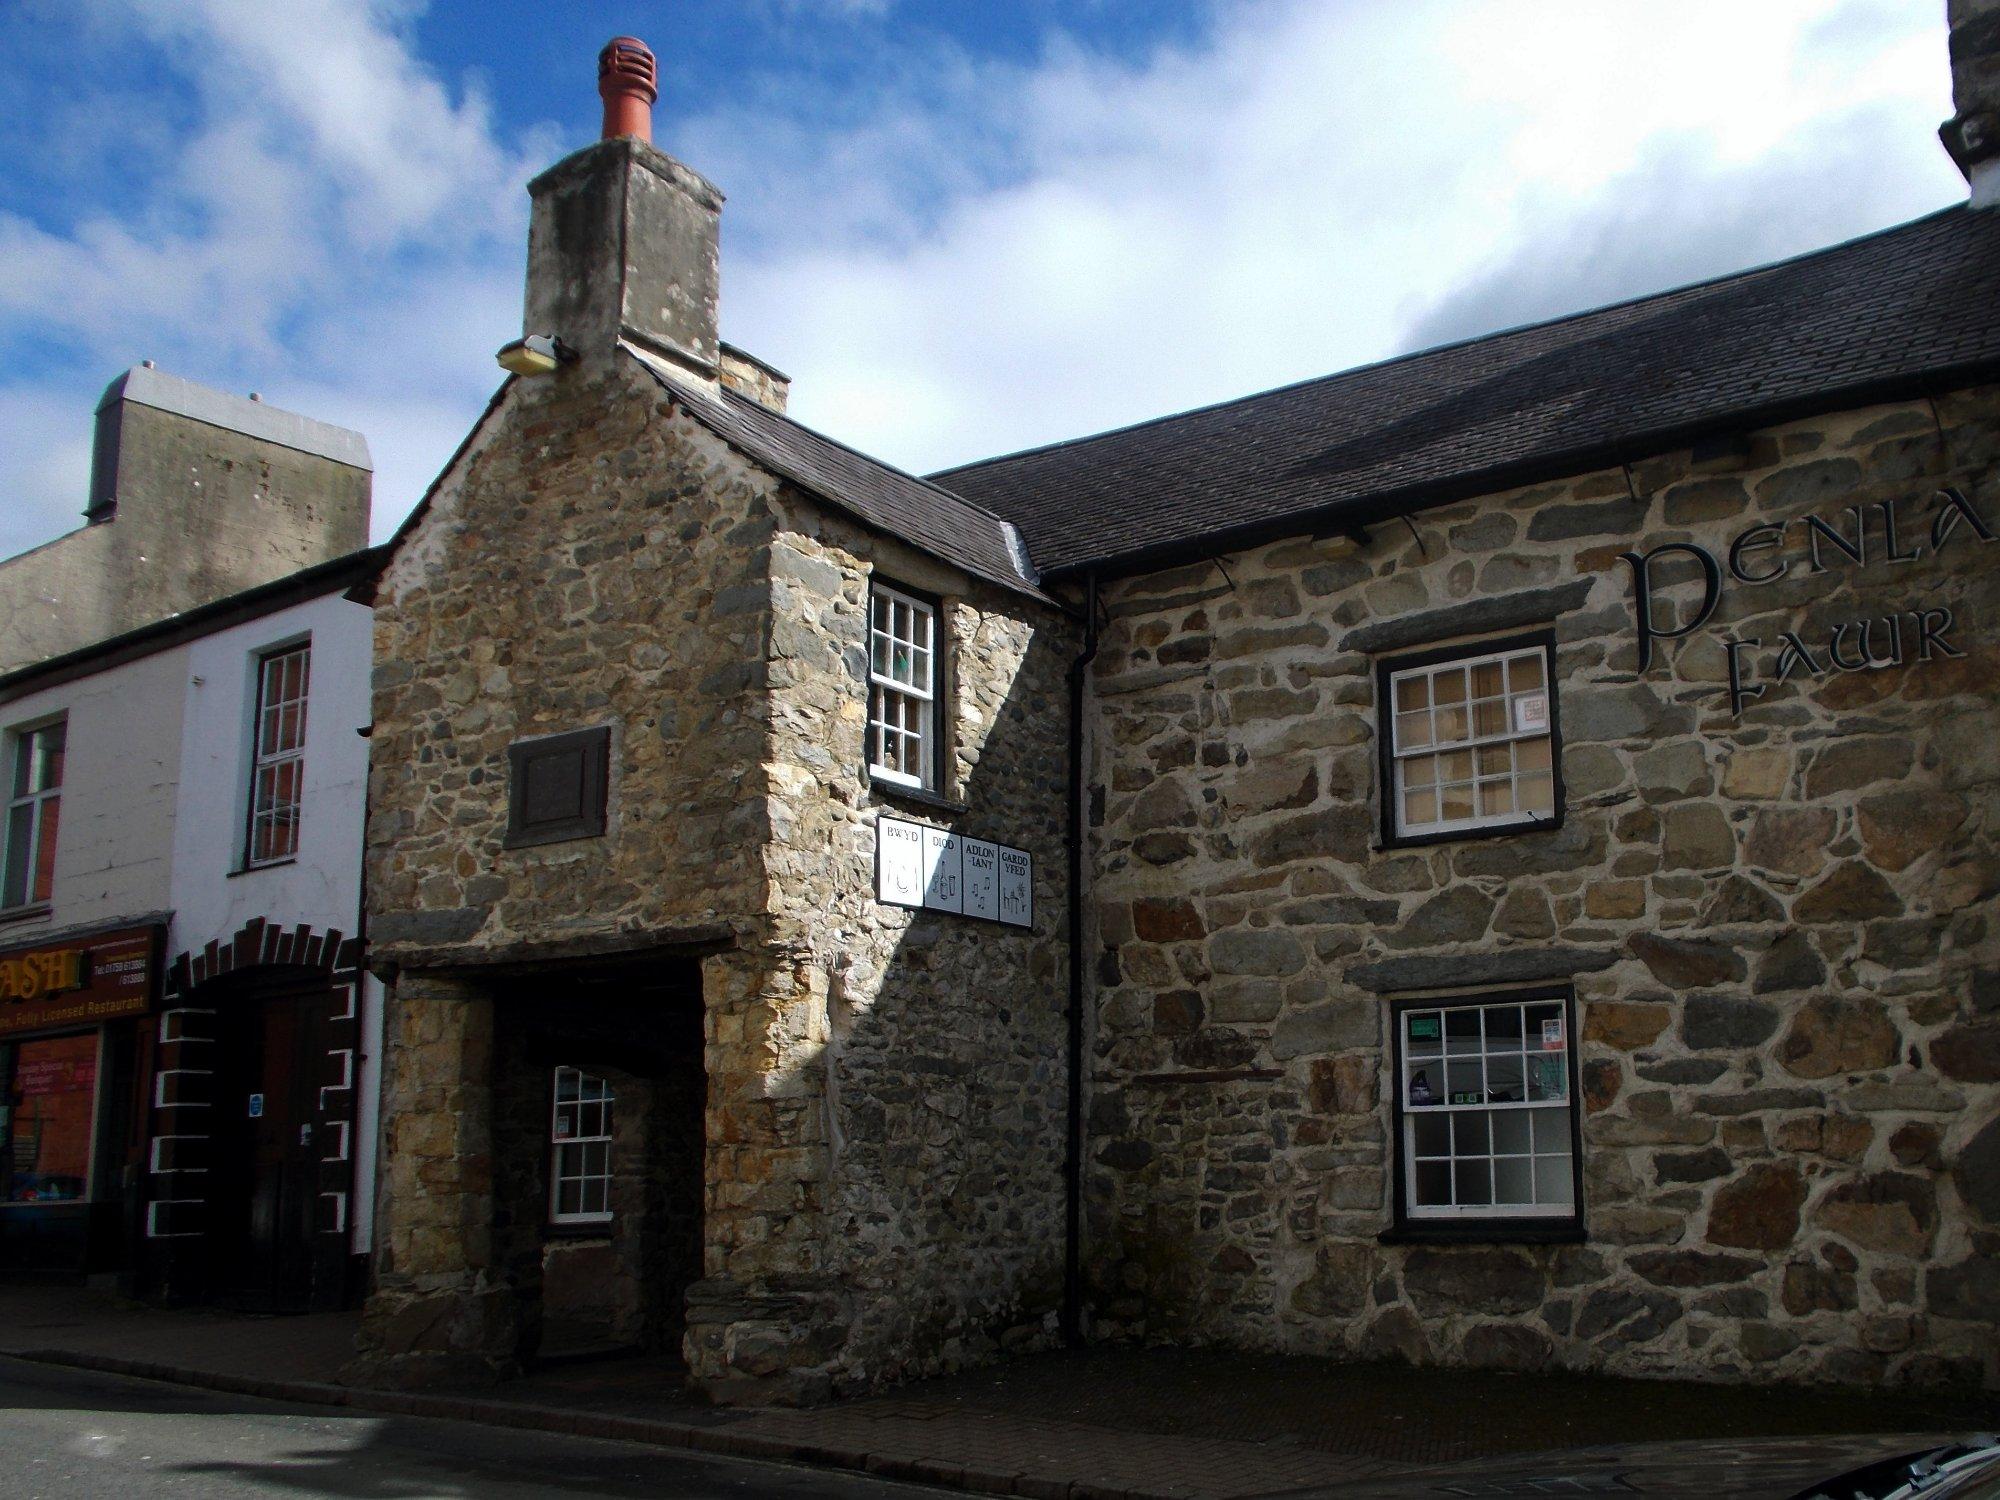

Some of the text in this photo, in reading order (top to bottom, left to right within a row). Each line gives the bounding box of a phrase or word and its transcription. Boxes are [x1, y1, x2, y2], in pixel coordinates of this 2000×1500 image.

[1721, 606, 1968, 719] FAWR
[887, 826, 918, 842] BWYD
[932, 836, 955, 850] DIOD
[965, 844, 995, 858] ADLON
[1001, 851, 1028, 867] GARDD
[1004, 865, 1026, 877] YFED
[16, 1008, 37, 1026] Fully
[42, 1004, 85, 1022] Licensed
[88, 995, 145, 1014] Restaurant
